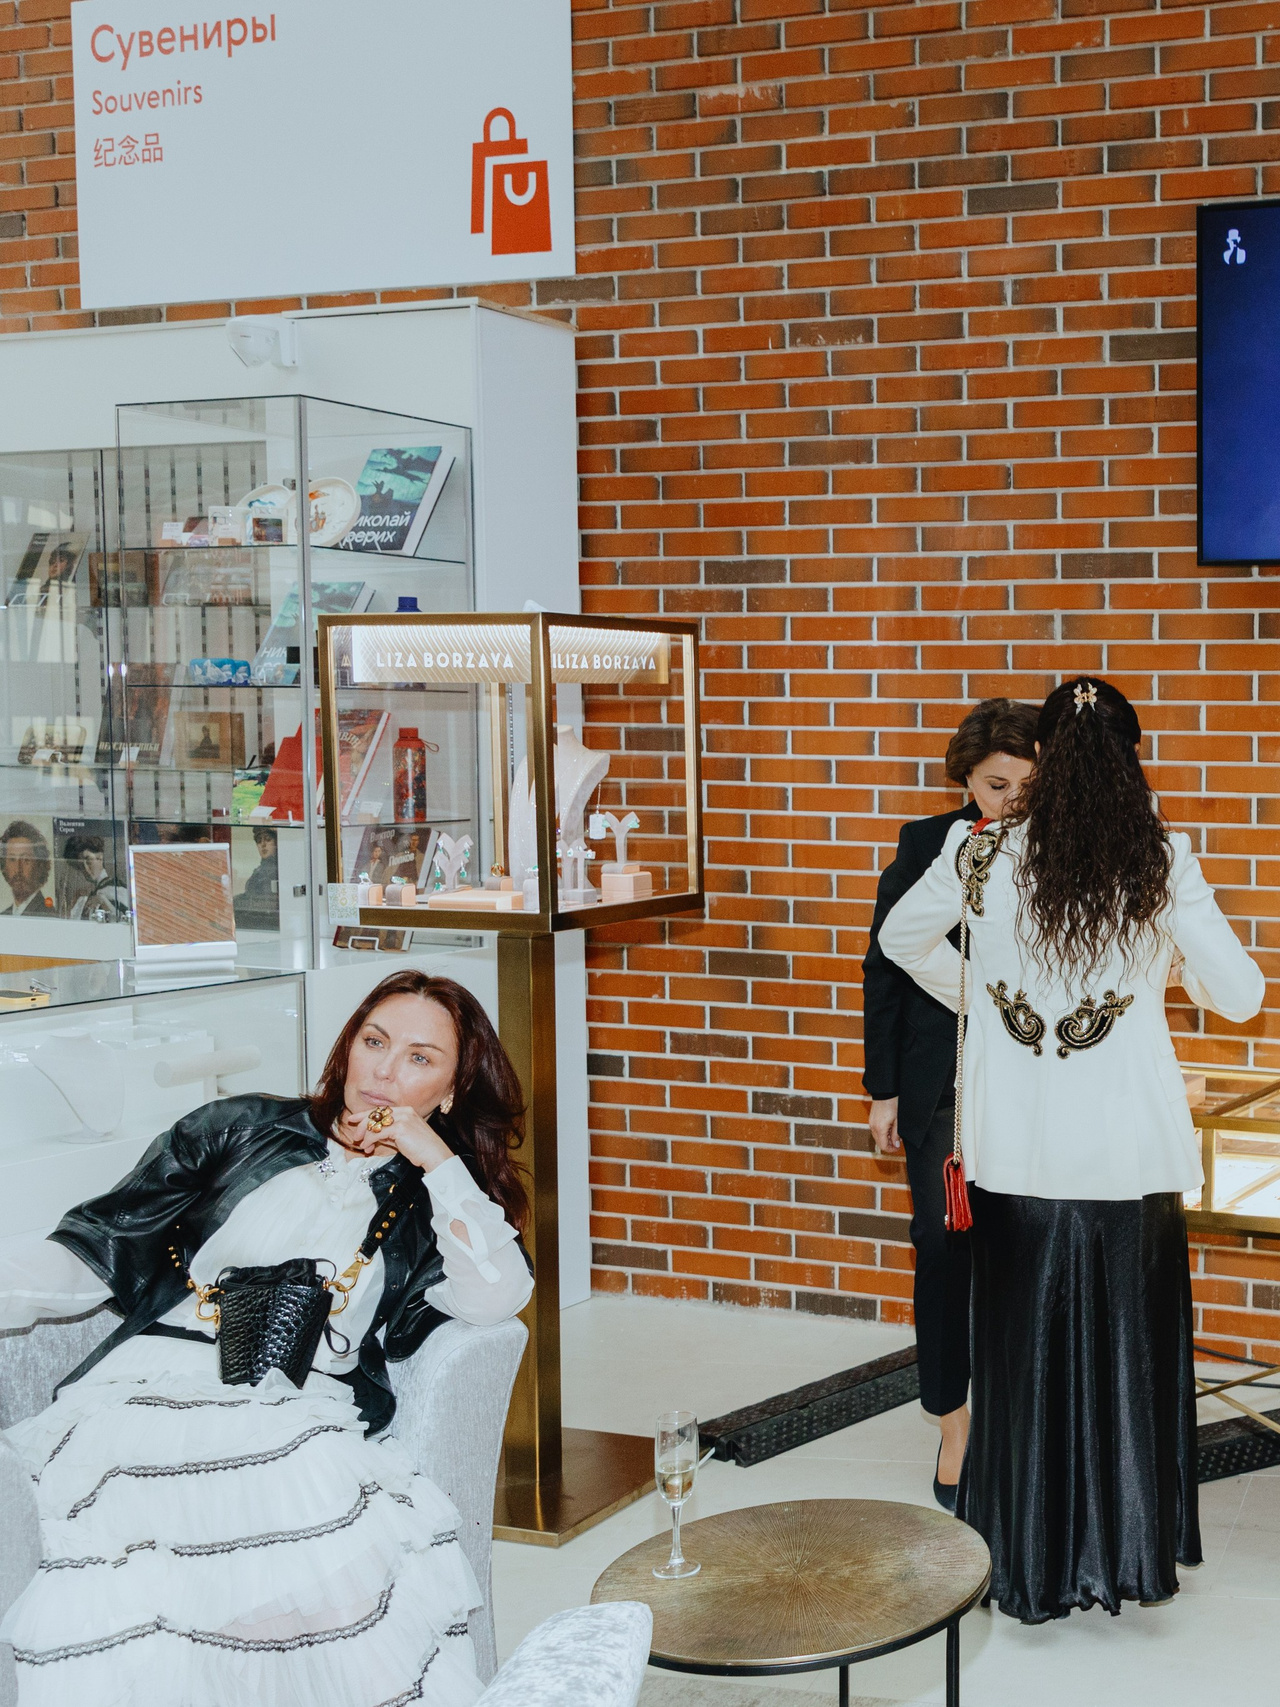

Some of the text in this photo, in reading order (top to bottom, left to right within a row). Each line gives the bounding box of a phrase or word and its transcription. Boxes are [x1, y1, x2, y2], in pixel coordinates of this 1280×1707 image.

[91, 14, 276, 71] Сувениры
[92, 80, 203, 115] Souvenirs
[94, 133, 163, 168] 纪念品
[353, 511, 411, 527] иколай
[376, 652, 514, 669] LIZA BORZAYA
[593, 654, 656, 670] BORZAYA
